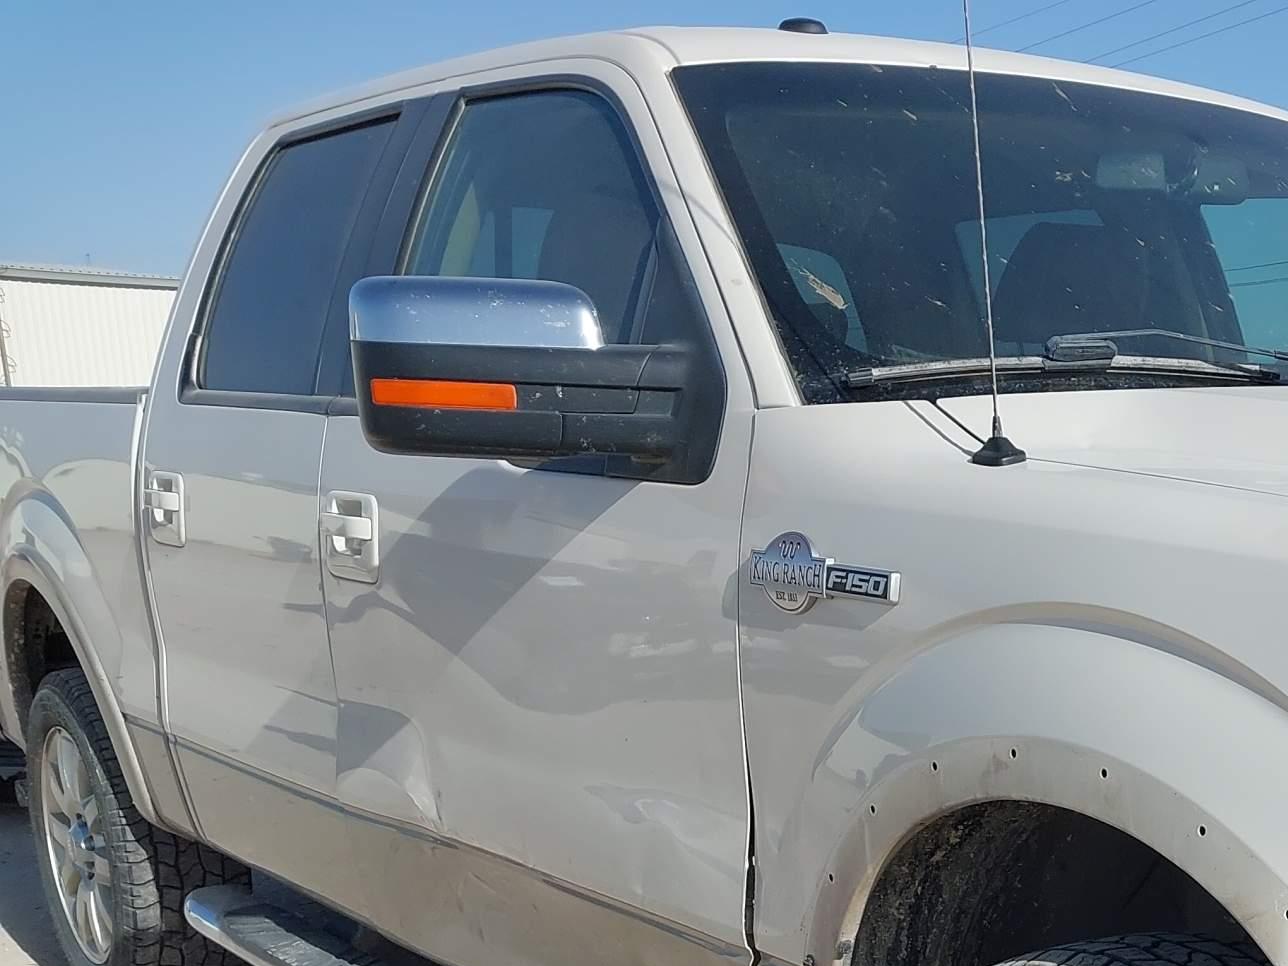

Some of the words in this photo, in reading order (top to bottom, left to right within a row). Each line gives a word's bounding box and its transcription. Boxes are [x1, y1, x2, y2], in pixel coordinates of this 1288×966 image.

[752, 556, 780, 583] KING
[782, 563, 822, 588] RANCH
[828, 571, 887, 596] F-150
